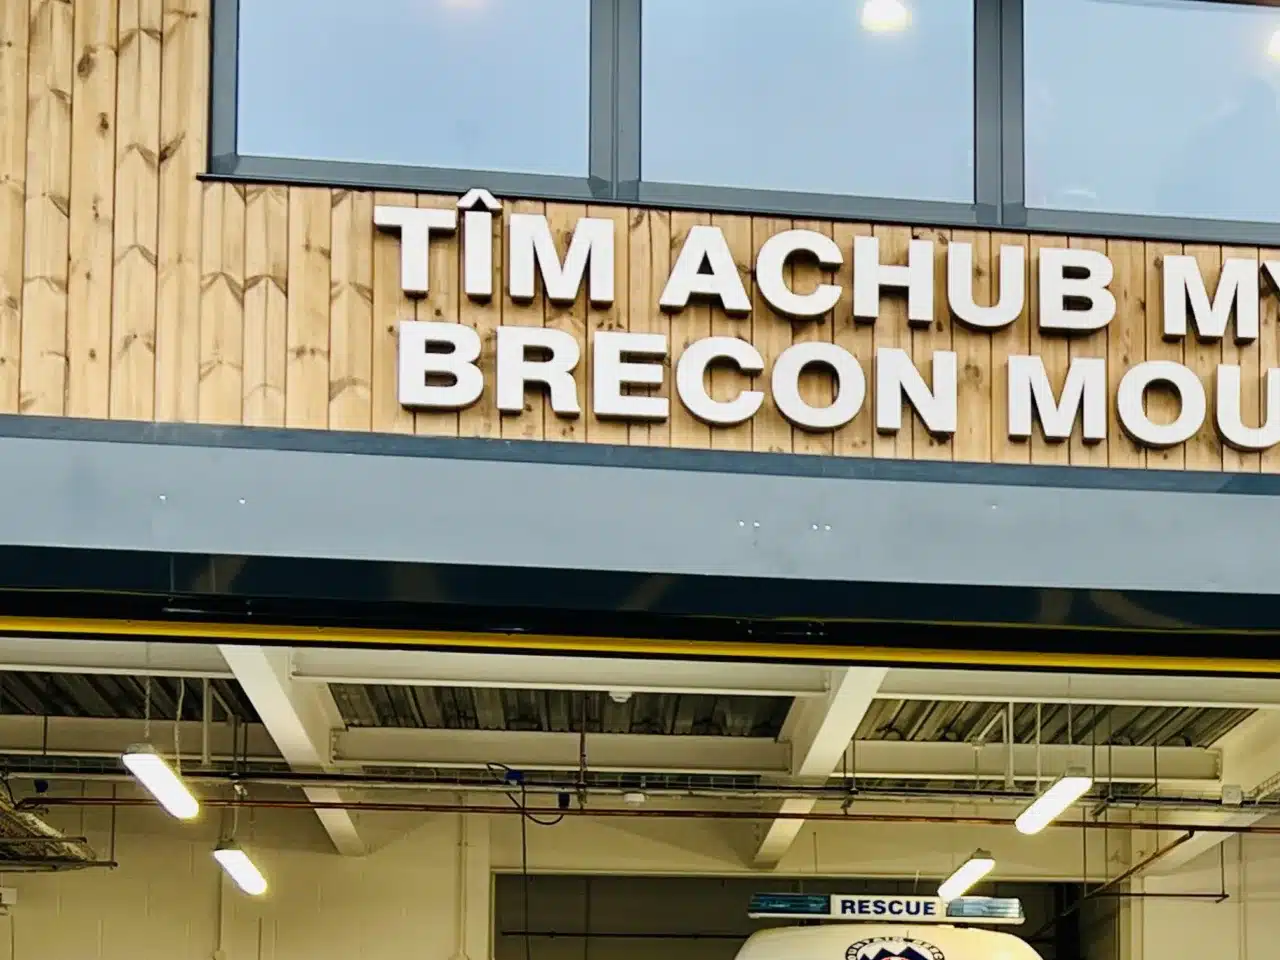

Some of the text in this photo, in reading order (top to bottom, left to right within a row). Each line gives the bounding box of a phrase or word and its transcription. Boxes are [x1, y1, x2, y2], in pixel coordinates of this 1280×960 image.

[372, 187, 615, 308] TÎM
[659, 224, 1117, 334] ACHUB
[398, 320, 958, 440] BRECON
[841, 899, 937, 915] RESCUE
